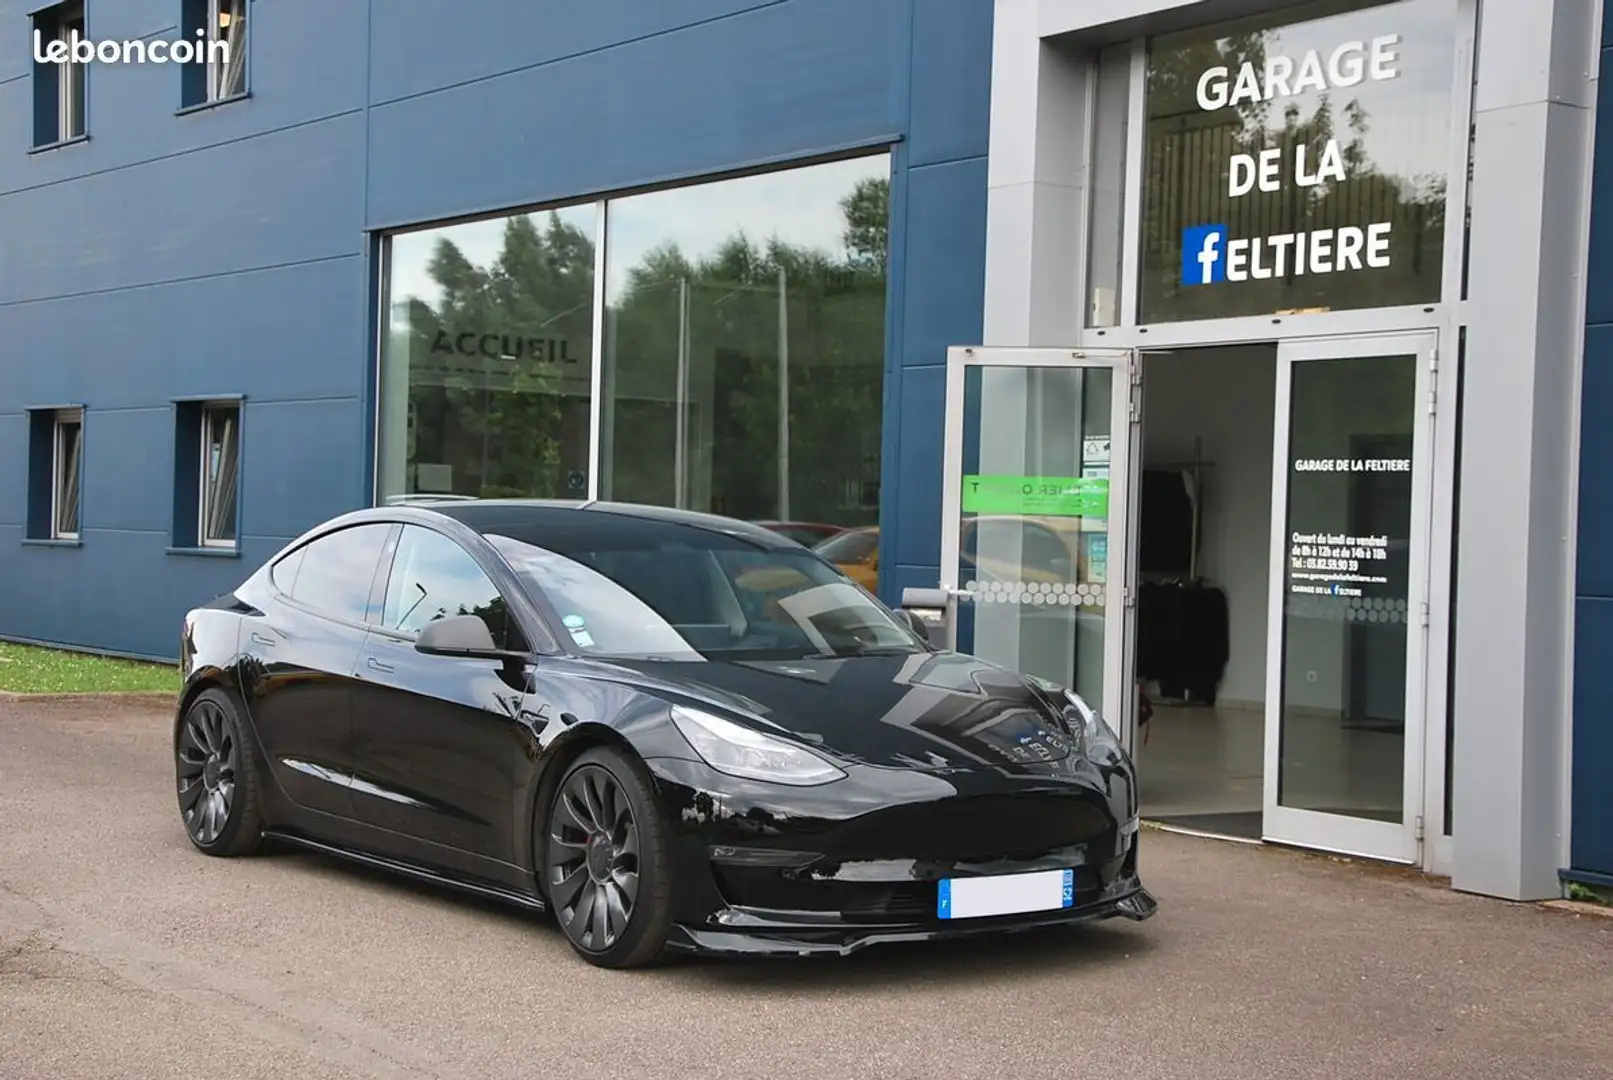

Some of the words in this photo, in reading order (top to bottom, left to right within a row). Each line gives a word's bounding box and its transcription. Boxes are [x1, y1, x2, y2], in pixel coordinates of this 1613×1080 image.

[1196, 34, 1402, 111] GARAGE
[1228, 148, 1282, 197] DE
[1294, 139, 1346, 187] LA
[430, 329, 578, 364] ACCUEIL
[1295, 459, 1334, 472] GARAGE
[1336, 459, 1350, 472] DE
[1351, 459, 1364, 472] LA
[1365, 459, 1410, 472] FELTIERE
[1292, 532, 1317, 544] Ouvert
[1317, 533, 1326, 544] du
[1327, 533, 1345, 545] lundi
[1346, 537, 1355, 545] au
[1356, 535, 1387, 546] vendredi
[1292, 545, 1301, 556] de
[1319, 546, 1331, 557] 12h
[1332, 547, 1340, 558] et
[1341, 547, 1350, 558] de
[1351, 547, 1364, 558] 14h
[1292, 585, 1315, 594] GARAGE
[1315, 586, 1323, 594] DE
